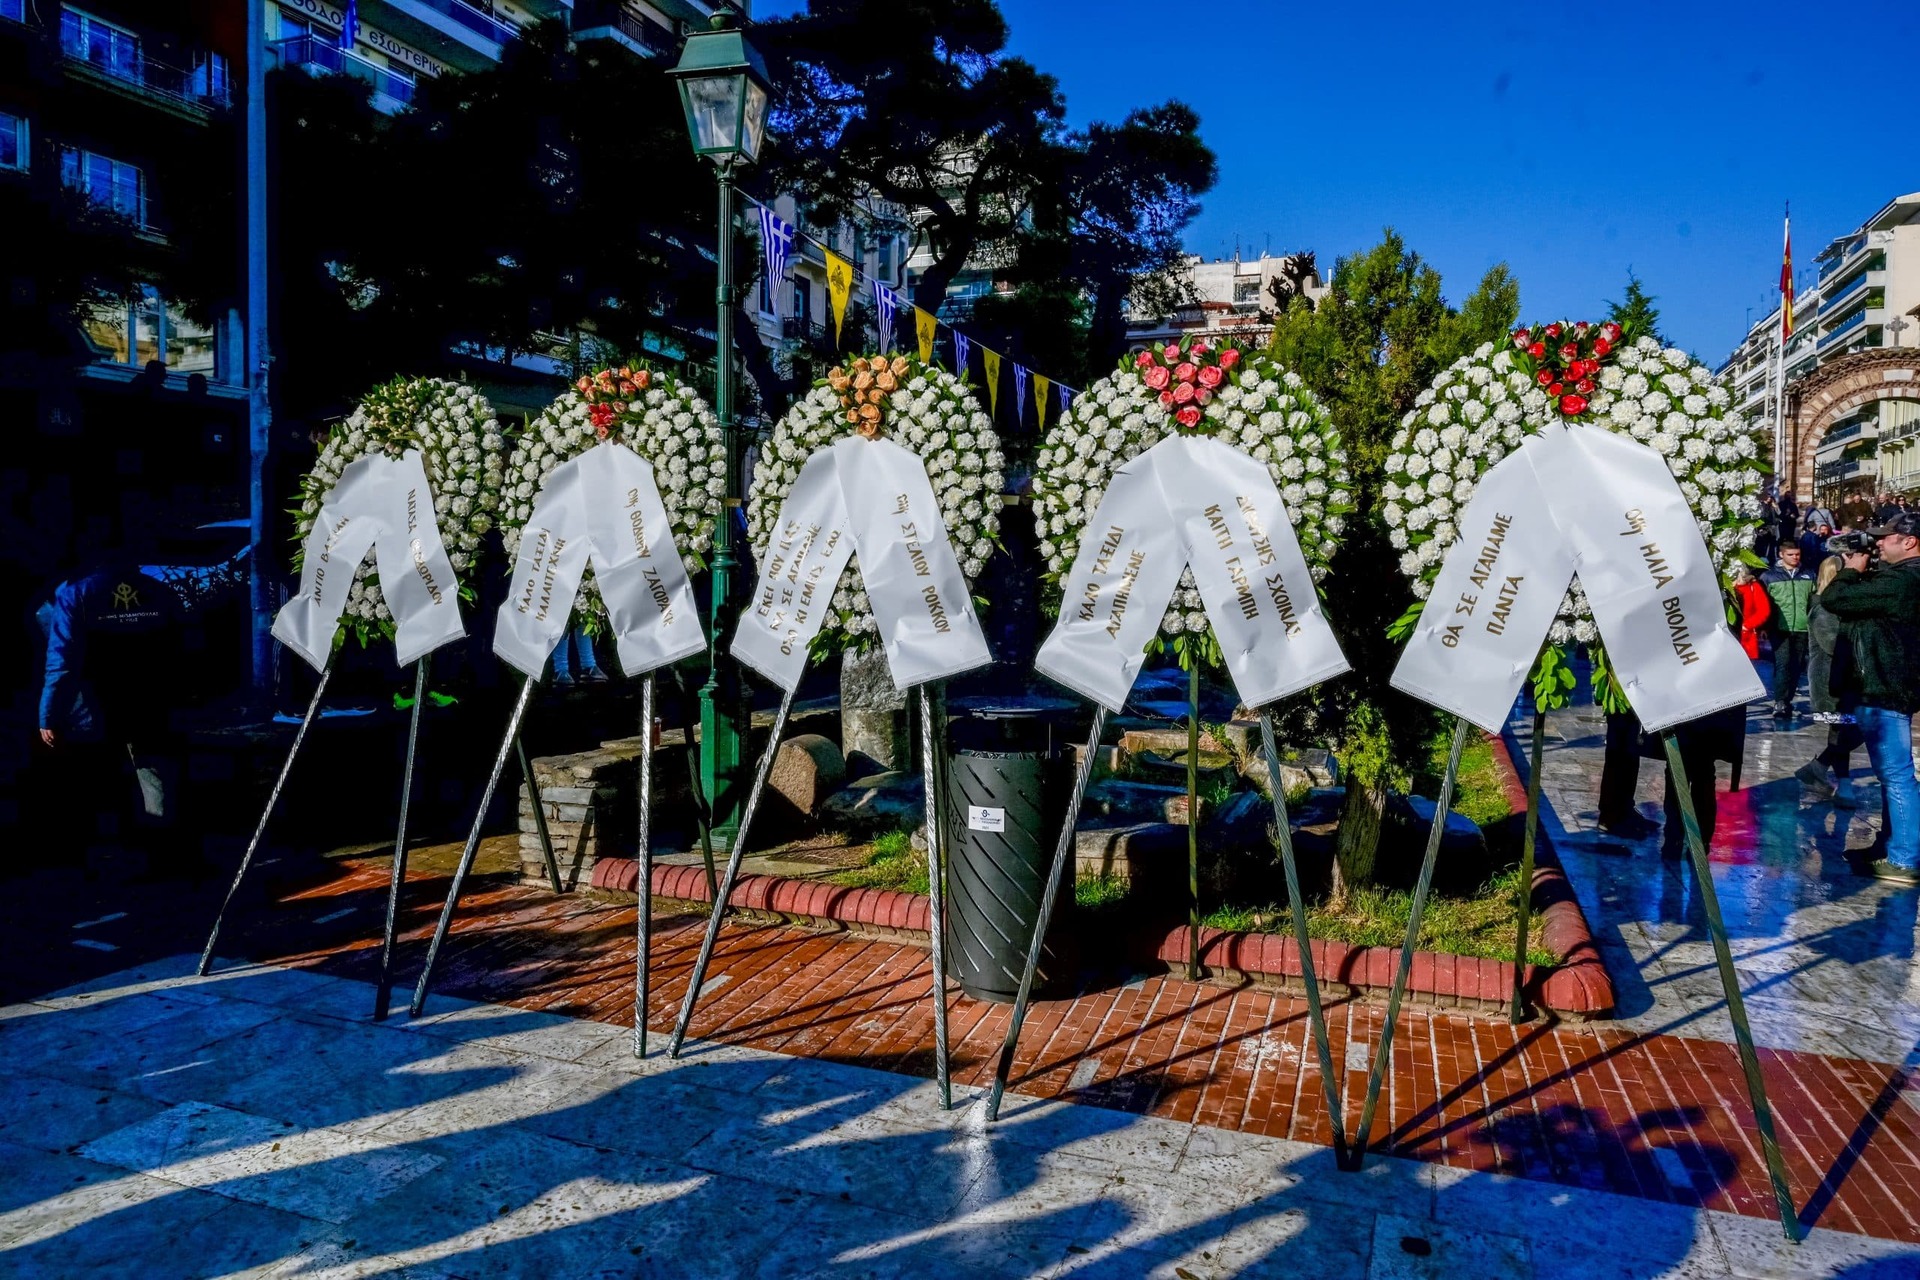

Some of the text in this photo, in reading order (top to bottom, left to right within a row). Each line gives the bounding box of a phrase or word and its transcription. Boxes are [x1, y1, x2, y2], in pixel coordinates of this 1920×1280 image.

[313, 567, 325, 607] ΑΝΤΙΟ
[407, 488, 443, 606] ΝΑΤΑΣΑ ΘΟΔΩΡΙΔΟΥ
[518, 527, 551, 614] ΚΑΛΟ ΤΑΞΙΔΙ
[901, 521, 930, 577] ΣΤΕΛΙΟΥ
[921, 585, 951, 634] ΡΟΚΚΟΥ
[1078, 525, 1125, 622] ΚΑΛΟ ΤΑΞΙΔΙ
[1204, 503, 1260, 621] ΚΑΙΤΗ ΓΑΡΜΠΗ
[1235, 495, 1303, 641] ΔΙΟΥΣΗΣ ΣΧΟΙΝΑΣ
[1441, 512, 1513, 649] ΘΑ ΣΕ ΑΓΑΠΑΜΕ
[758, 586, 775, 617] ΕΚΕΙ
[781, 587, 794, 607] ΣΕ
[795, 609, 808, 625] ΚΙ
[1105, 549, 1146, 640] ΑΓΑΠΗΜΕΝΕ
[1486, 576, 1524, 636] ΠΑΝΤΑ
[1640, 542, 1674, 589] ΗΛΙΑ
[1662, 596, 1700, 666] ΒΙΟΛΙΔΗ
